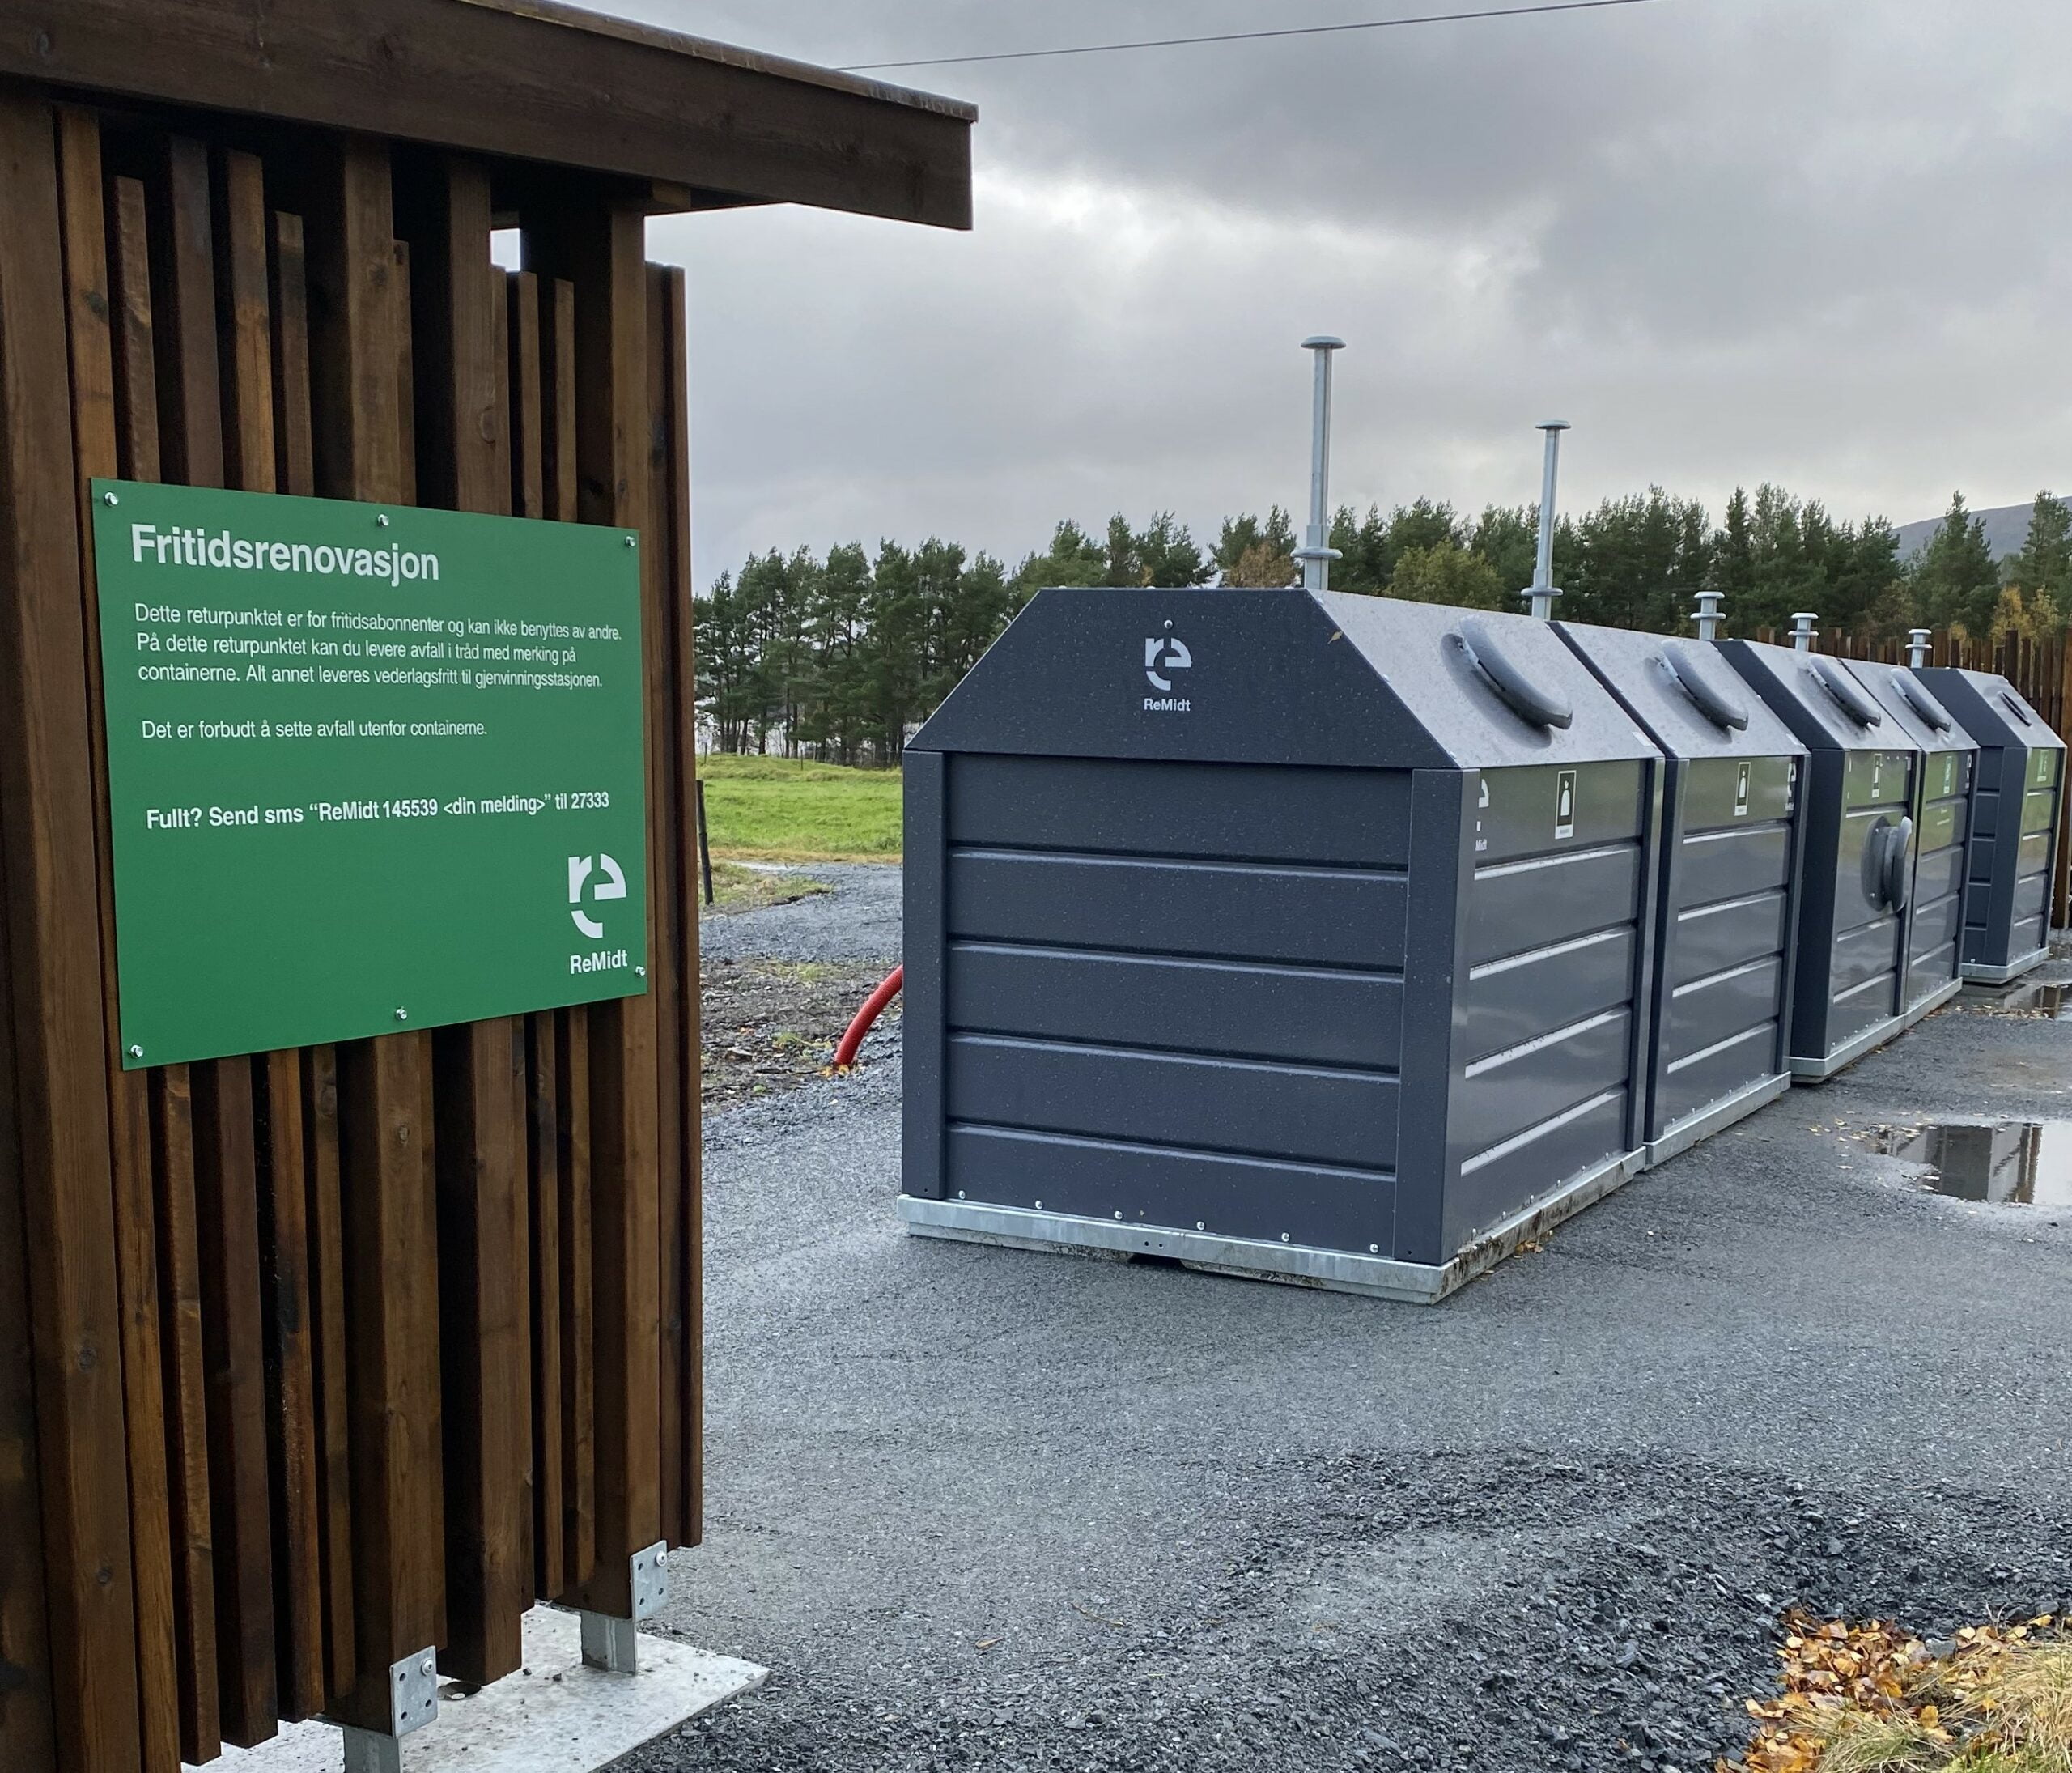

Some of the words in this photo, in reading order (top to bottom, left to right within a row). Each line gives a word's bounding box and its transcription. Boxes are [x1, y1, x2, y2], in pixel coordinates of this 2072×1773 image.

[130, 522, 440, 587] Fritidsrenovasjon
[134, 602, 181, 623] Dette
[186, 606, 283, 629] returpunktet
[287, 613, 304, 627] er
[306, 610, 328, 628] for
[330, 610, 445, 632] fritidsabonnenter
[448, 620, 465, 638] og
[467, 618, 490, 635] kan
[494, 619, 518, 636] ikke
[520, 620, 570, 641] benyttes
[571, 626, 586, 639] av
[588, 624, 622, 640] andre.
[137, 631, 161, 652] På
[165, 633, 208, 653] dette
[213, 636, 308, 658] returpunktet
[311, 637, 338, 656] kan
[342, 639, 361, 657] du
[365, 640, 406, 658] levere
[410, 641, 444, 659] avfall
[448, 642, 452, 659] i
[454, 642, 480, 660] tråd
[482, 644, 510, 661] med
[513, 645, 559, 666] merking
[562, 646, 577, 666] på
[138, 662, 240, 682] containerne.
[245, 664, 267, 682] Alt
[271, 666, 315, 682] annet
[318, 665, 371, 683] leveres
[373, 666, 459, 689] vederlagsfritt
[461, 668, 472, 685] til
[474, 669, 603, 691] gjenvinningsstasjonen.
[1144, 698, 1191, 712] ReMidt
[142, 720, 172, 739] Det
[176, 724, 195, 738] er
[197, 720, 257, 738] forbudt
[260, 719, 271, 738] å
[275, 721, 312, 738] sette
[316, 719, 355, 737] avfall
[359, 719, 407, 737] utenfor
[410, 719, 487, 736] containerne.
[146, 807, 202, 830] Fullt?
[209, 805, 259, 827] Send
[264, 807, 304, 824] sms
[382, 798, 439, 818] 145539
[443, 797, 477, 815] <din
[554, 793, 568, 810] til
[571, 791, 609, 810] 27333
[570, 949, 628, 975] ReMidt
